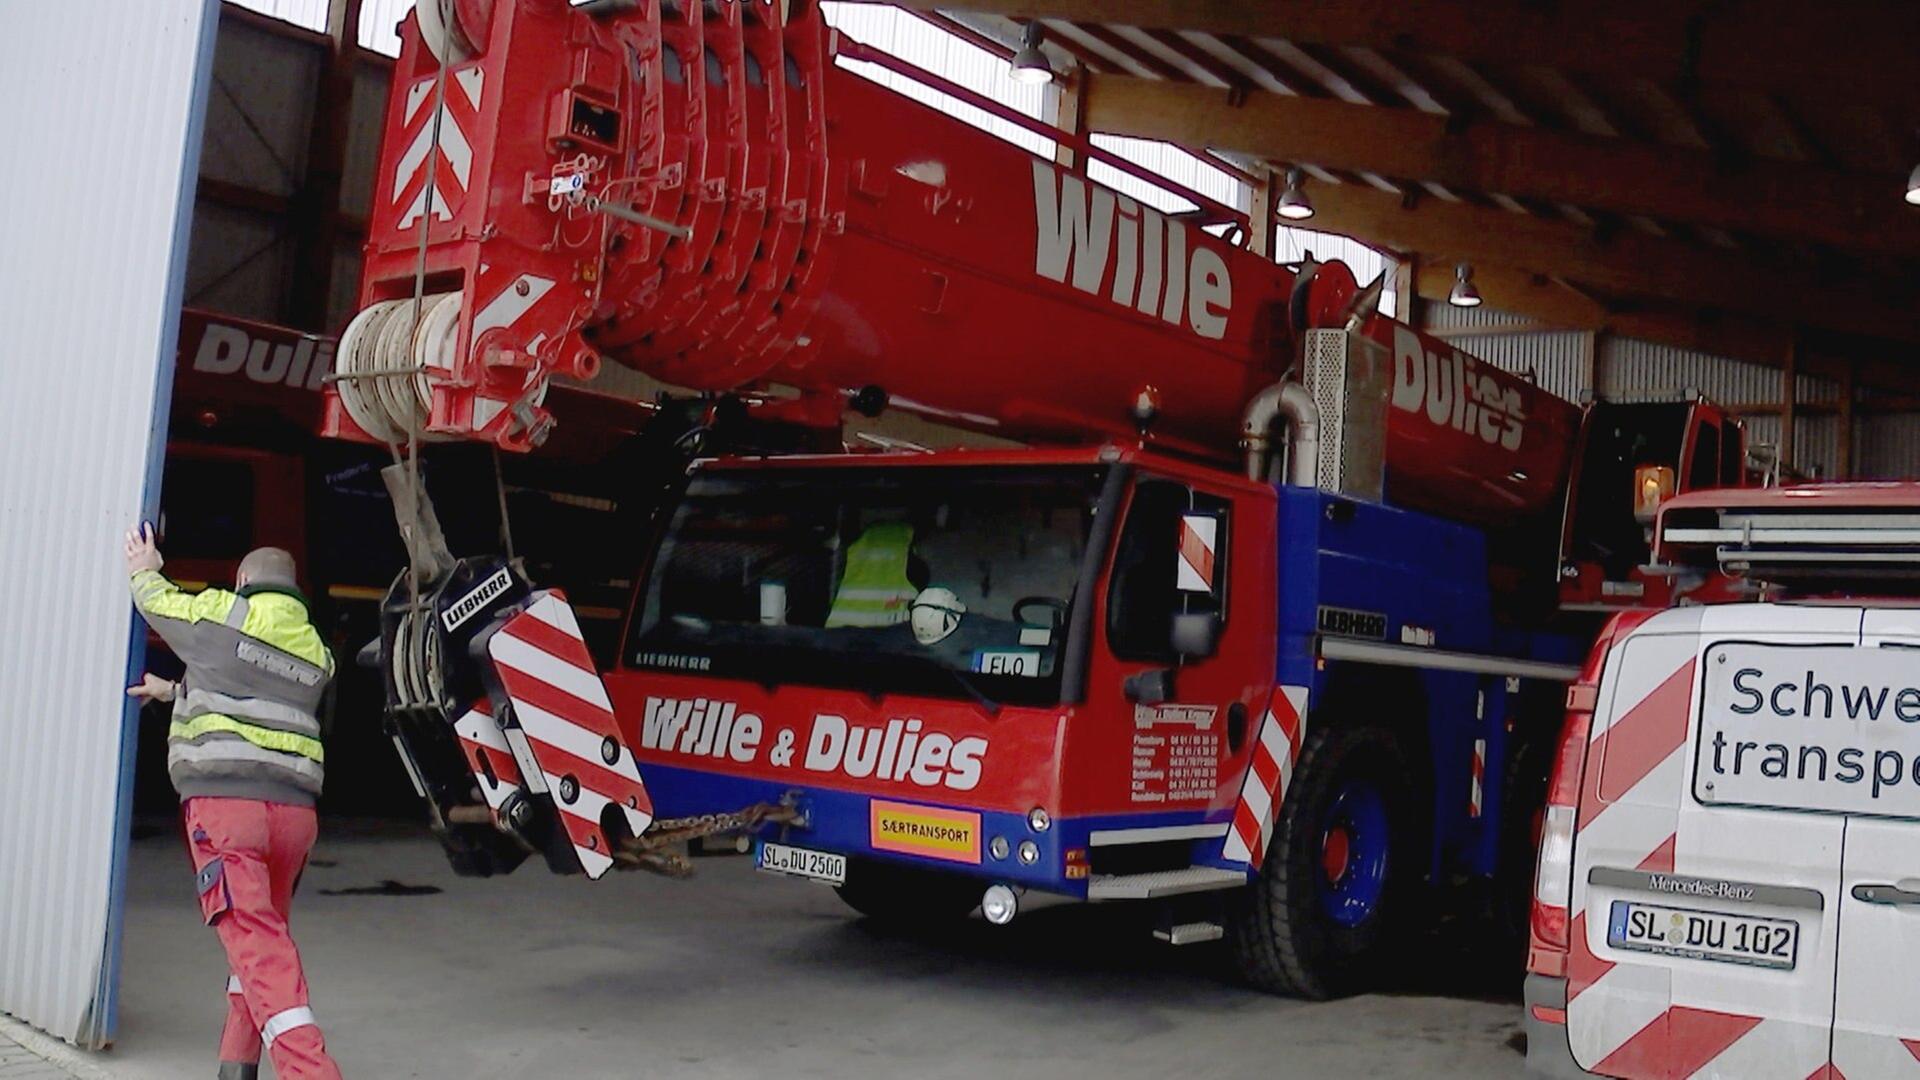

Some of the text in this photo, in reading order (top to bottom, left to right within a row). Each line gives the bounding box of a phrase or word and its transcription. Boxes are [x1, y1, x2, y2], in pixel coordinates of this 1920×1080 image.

[1032, 159, 1527, 451] Wille Dulies
[193, 323, 335, 391] Duli
[446, 573, 508, 626] LIEBHERR
[636, 652, 711, 671] LIEBHERR
[641, 696, 989, 791] Wille & Dulies
[1712, 731, 1920, 799] transp
[882, 819, 969, 843] SÆRTRANSPORT
[764, 846, 842, 876] SL DU 2500
[1649, 875, 1754, 900] Mercedes-Benz
[1629, 911, 1665, 941] SL
[1686, 917, 1726, 948] DU
[1733, 923, 1790, 957] 102
